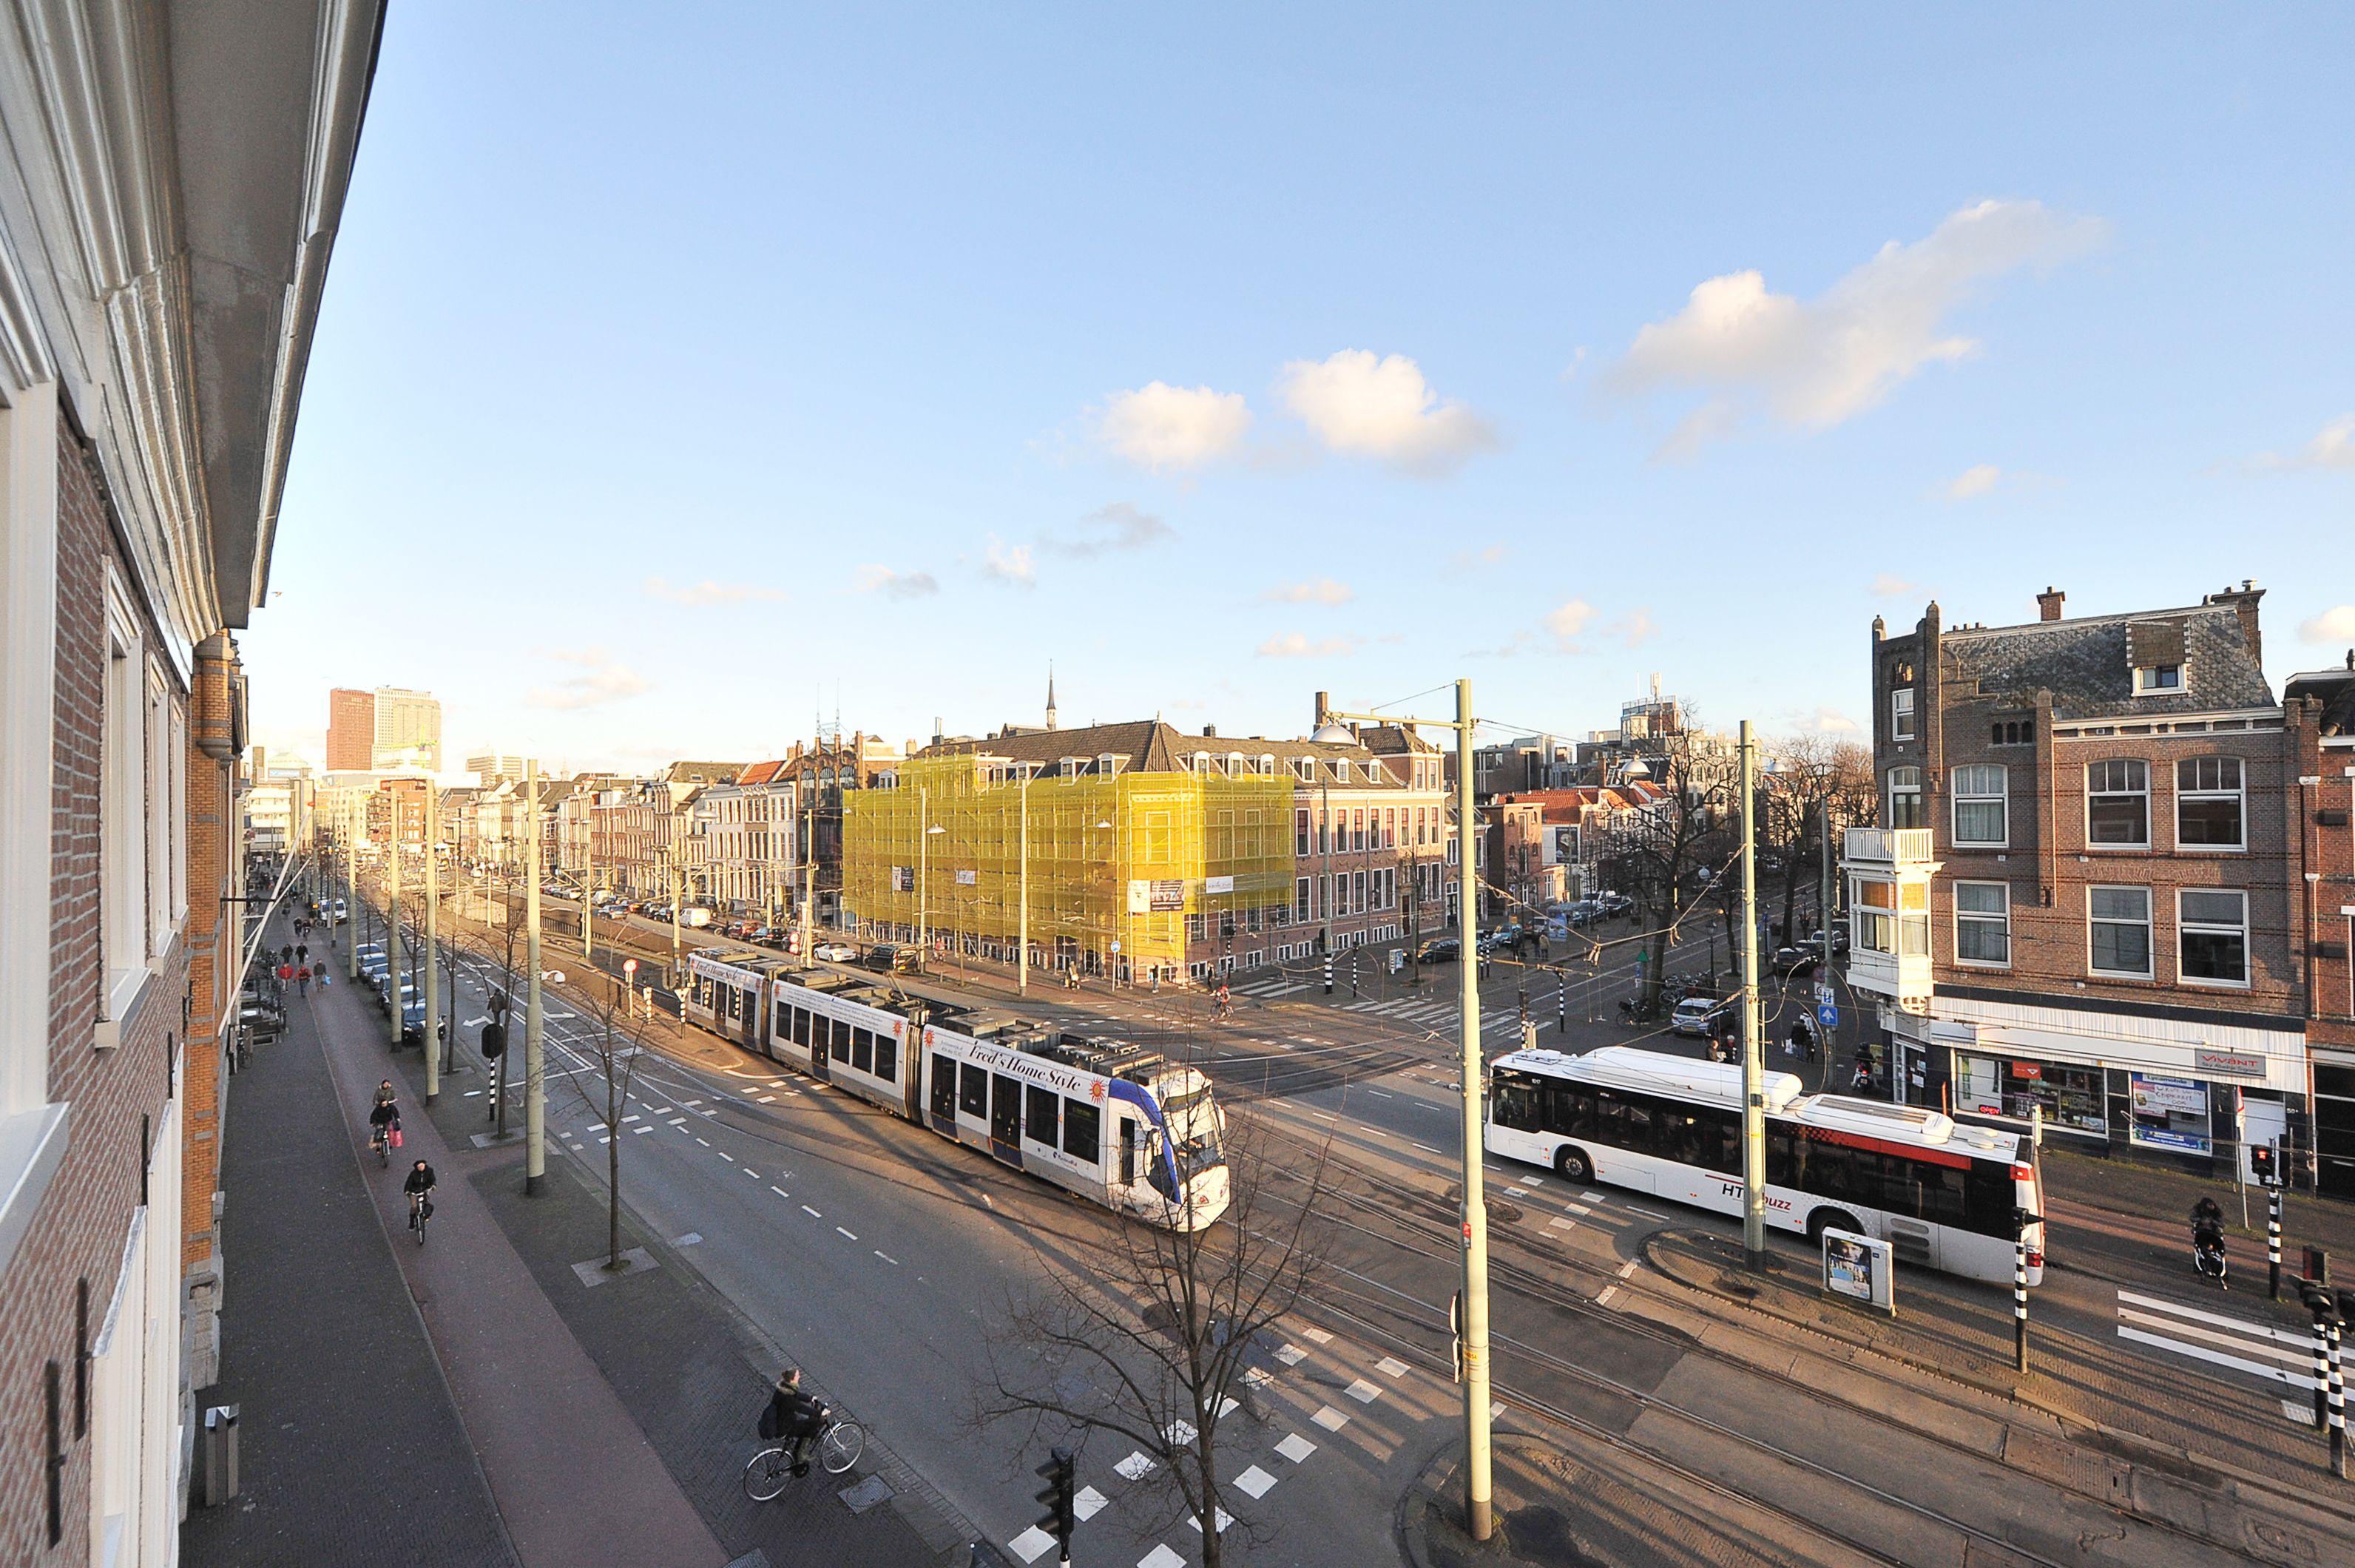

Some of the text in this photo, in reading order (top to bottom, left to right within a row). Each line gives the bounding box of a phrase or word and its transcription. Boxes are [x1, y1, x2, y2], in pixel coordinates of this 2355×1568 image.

[969, 1040, 1007, 1067] Fred's
[1007, 1058, 1046, 1080] Home
[1046, 1069, 1081, 1091] Style
